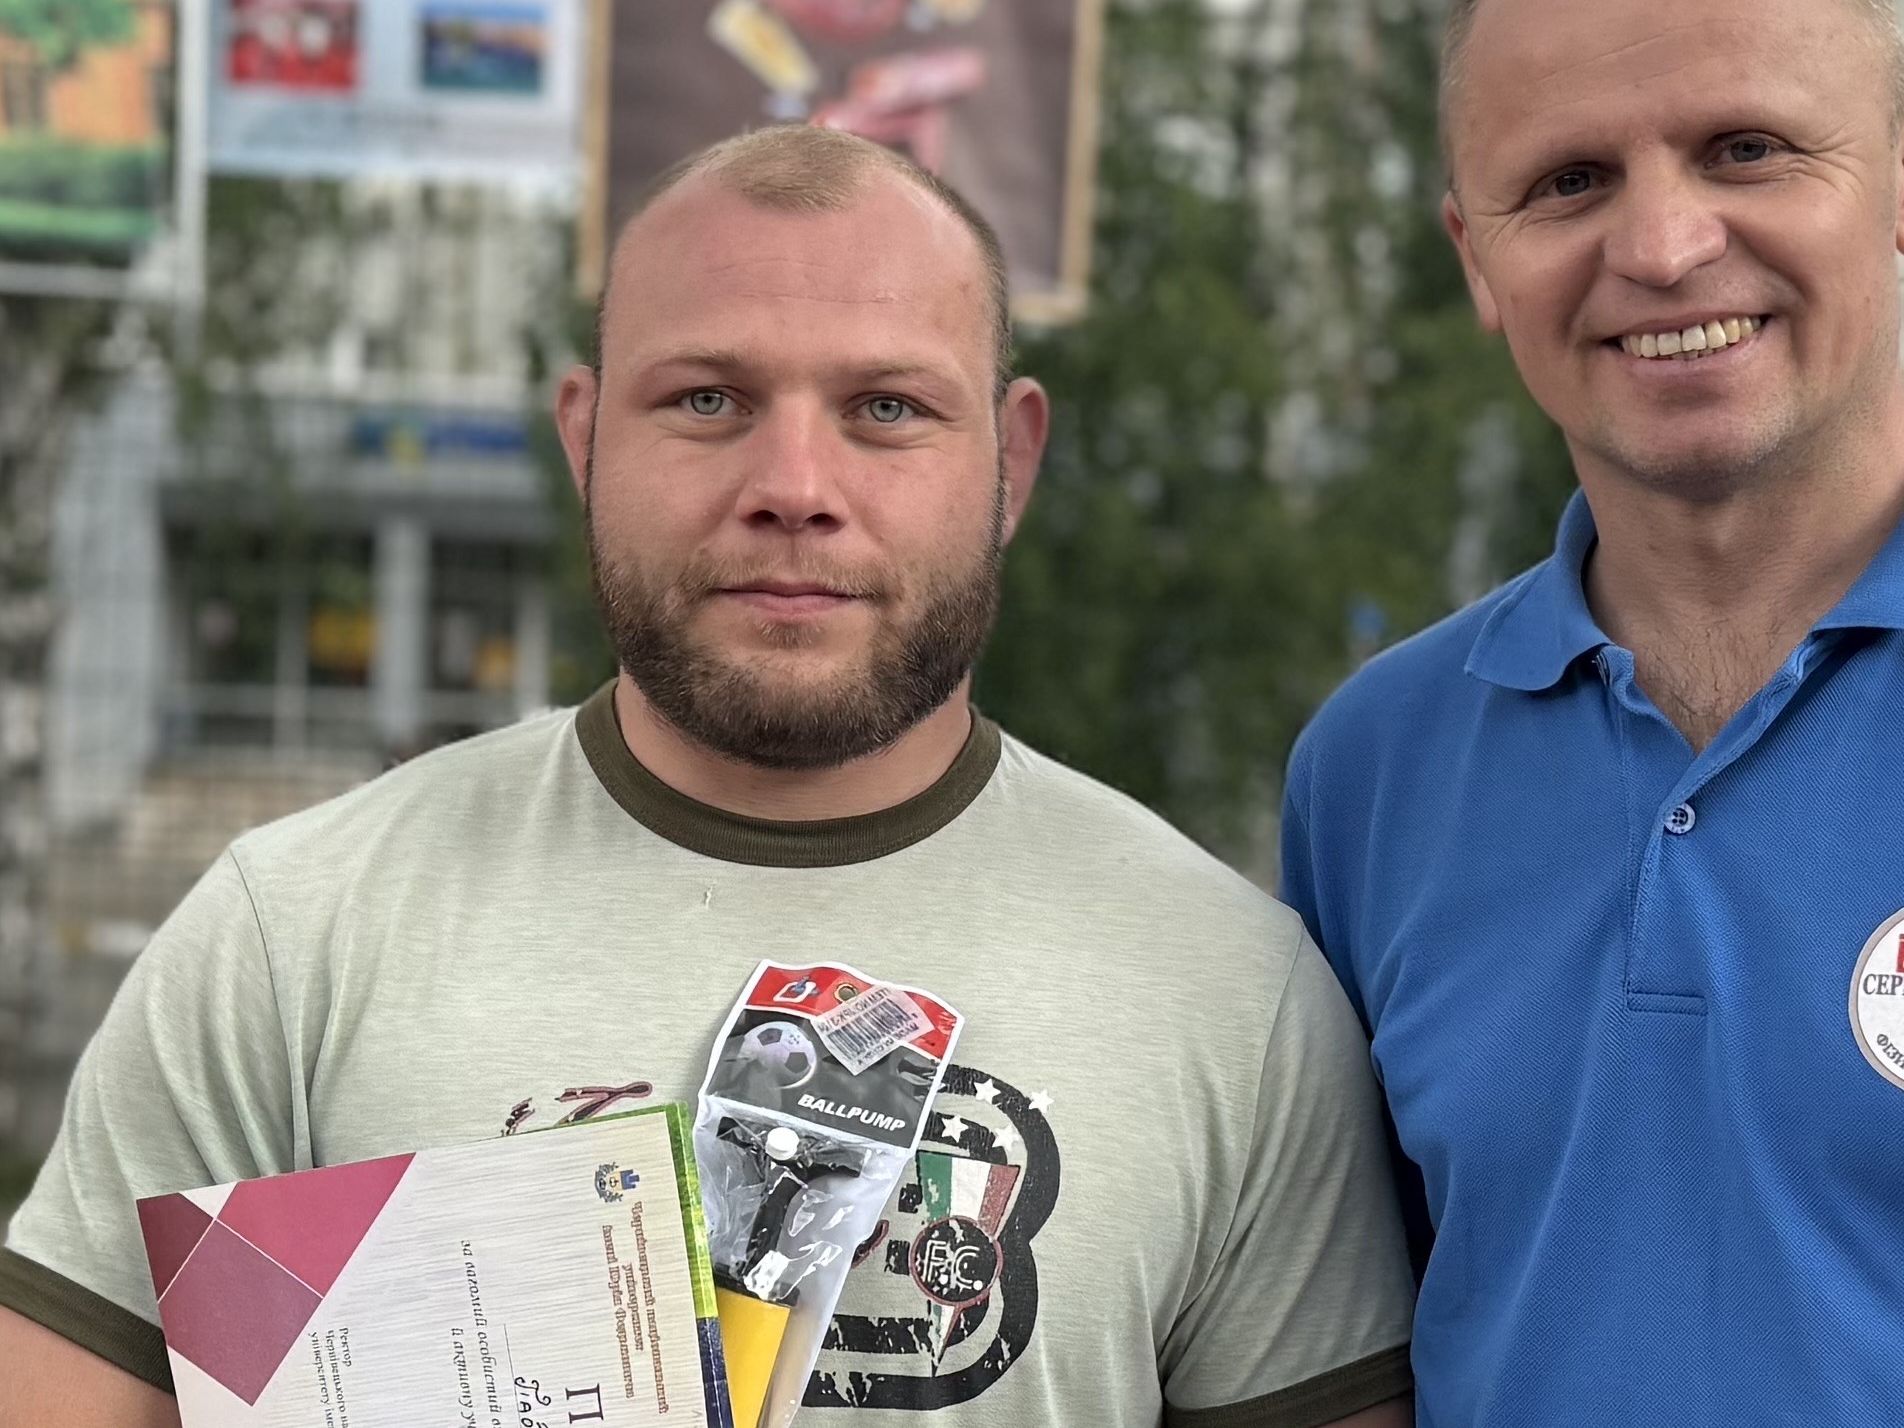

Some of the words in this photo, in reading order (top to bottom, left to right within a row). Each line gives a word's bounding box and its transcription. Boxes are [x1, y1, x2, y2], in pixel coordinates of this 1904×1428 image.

[798, 1093, 905, 1132] BALLPUMP
[460, 1239, 473, 1256] за
[463, 1260, 487, 1327] вагомий
[308, 1331, 332, 1405] університету
[323, 1329, 347, 1413] Чернівецького
[336, 1327, 353, 1367] Ректор
[450, 1340, 473, 1410] активну
[476, 1330, 502, 1413] особистий
